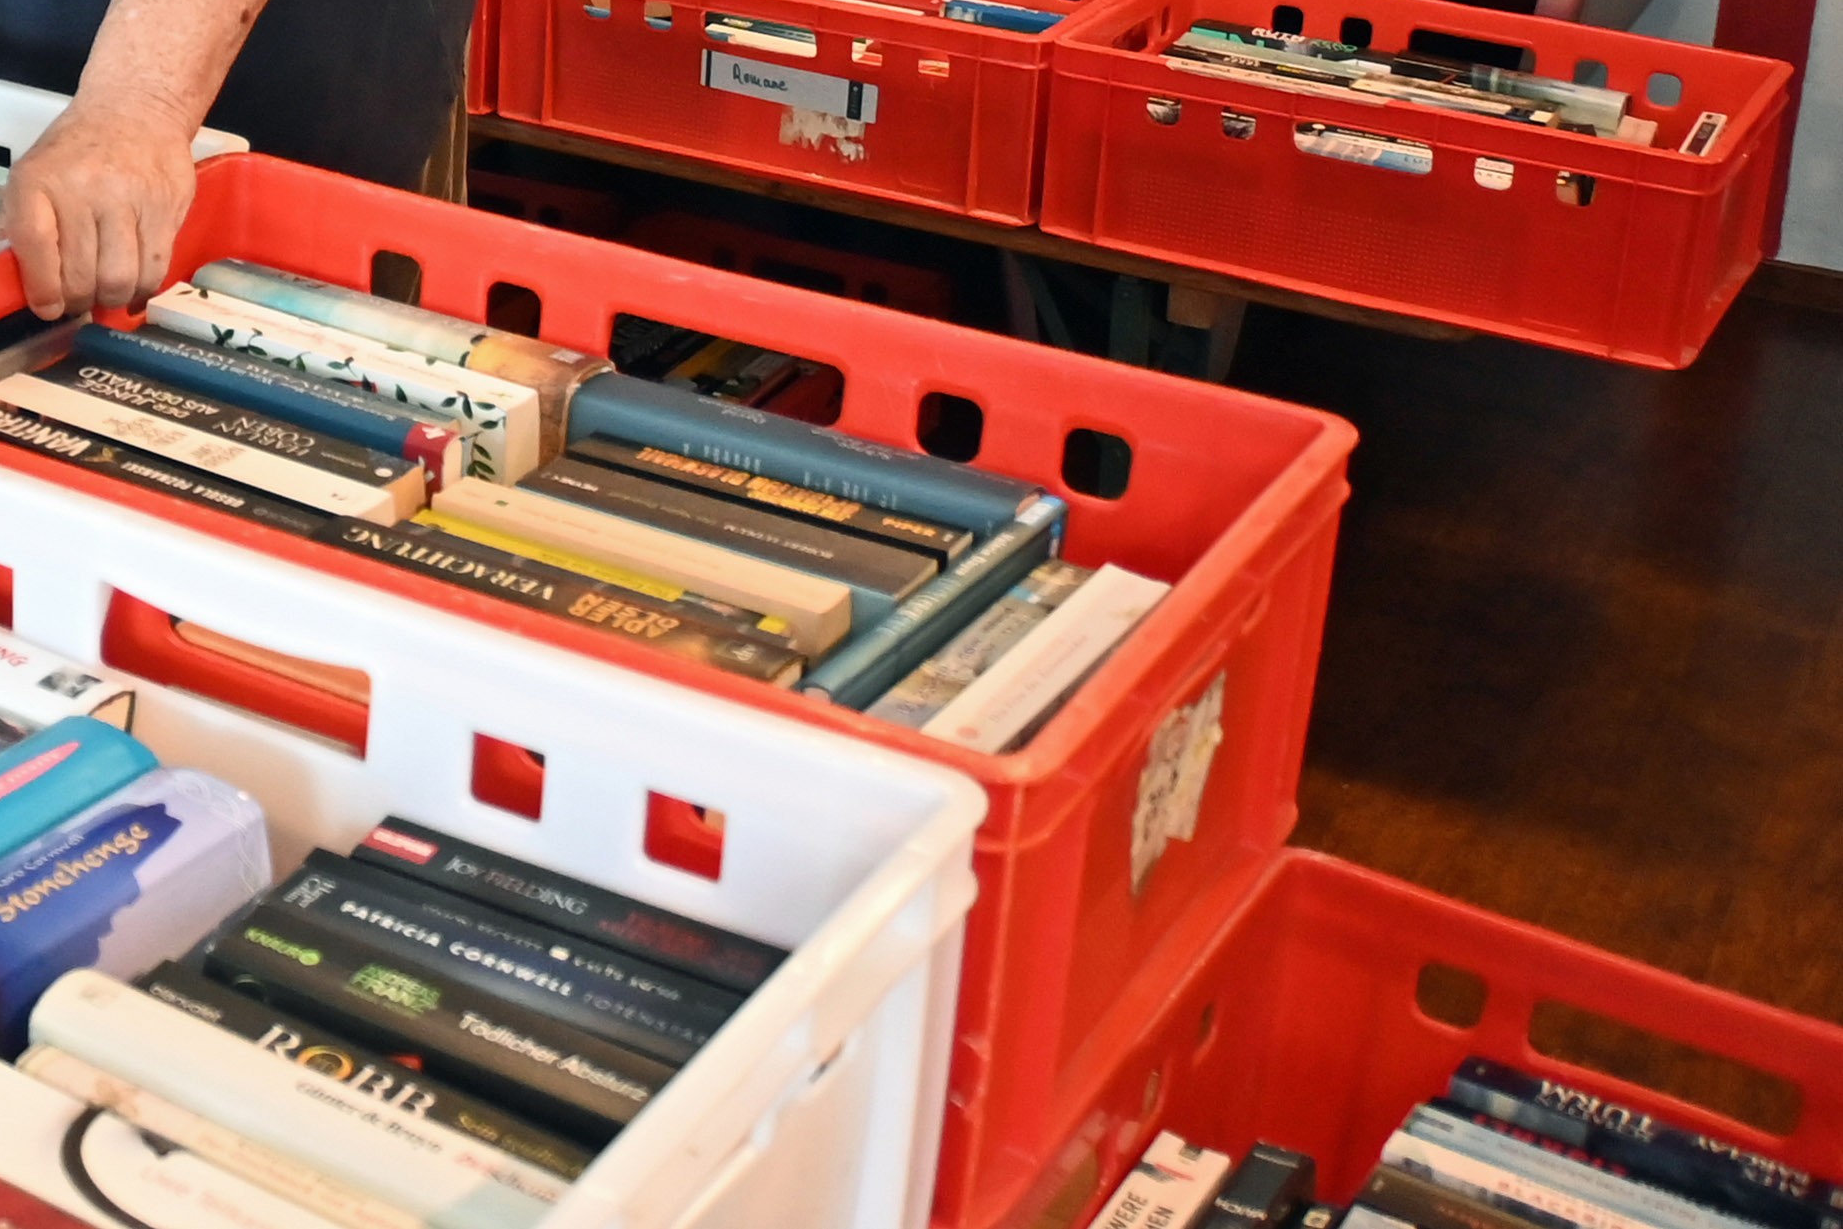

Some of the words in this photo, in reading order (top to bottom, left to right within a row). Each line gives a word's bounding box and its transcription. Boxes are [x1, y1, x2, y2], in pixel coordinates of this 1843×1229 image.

[733, 62, 788, 91] Romane
[75, 379, 155, 409] JUNGE
[78, 365, 145, 399] WALD
[146, 388, 184, 410] DEM
[152, 404, 190, 419] DER
[184, 399, 220, 417] AUS
[213, 420, 311, 458] HARLAN
[237, 415, 316, 450] COBEN
[121, 461, 195, 491] POZNANSKI
[194, 484, 247, 509] URSULA
[343, 526, 554, 601] VERACHTUNG
[483, 870, 589, 917] FIELDING
[339, 899, 443, 950] PATRICIA
[448, 940, 574, 998] CORNWELL
[458, 1011, 560, 1069] Tödlicher
[256, 1023, 437, 1119] ROBB
